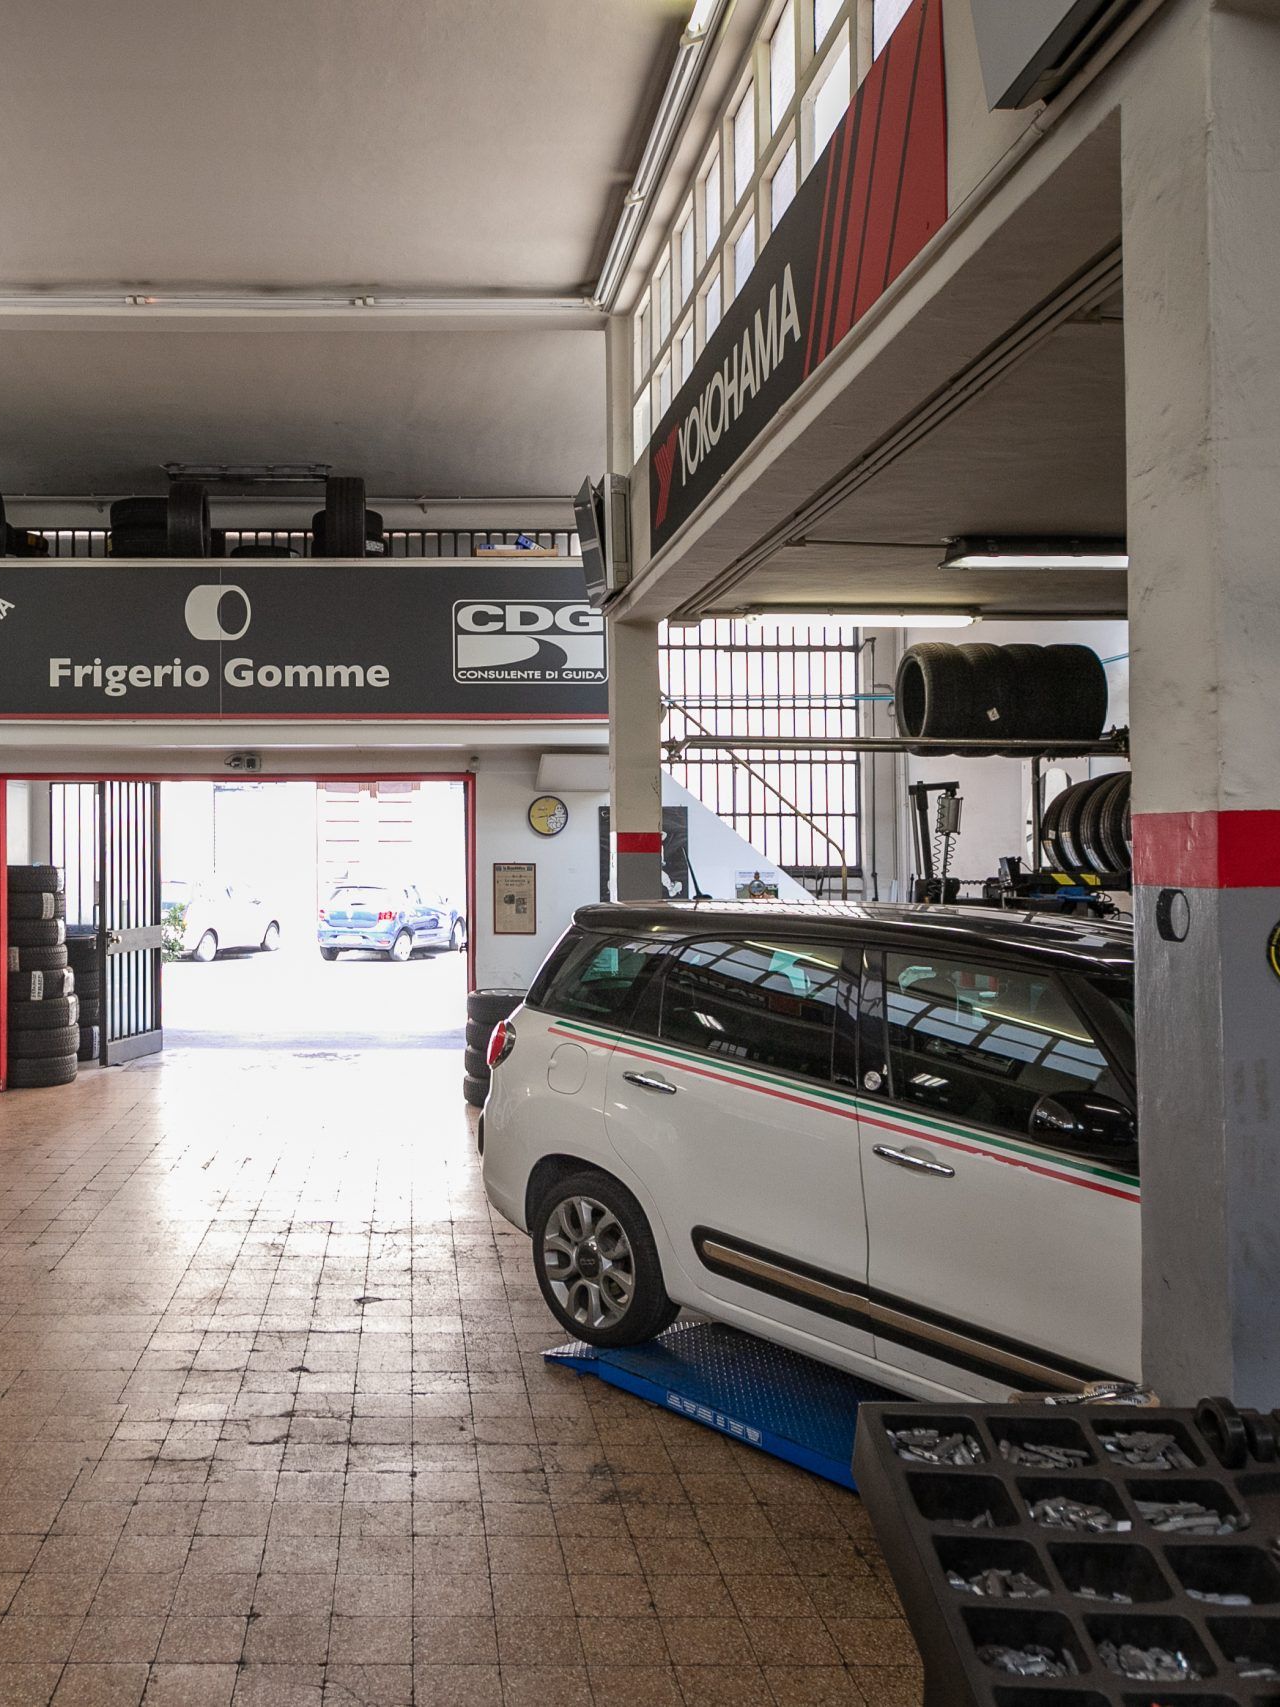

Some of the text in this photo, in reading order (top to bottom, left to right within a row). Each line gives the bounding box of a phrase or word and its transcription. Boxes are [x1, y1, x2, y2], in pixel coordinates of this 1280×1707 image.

[678, 262, 802, 487] YOKOHAMA
[456, 604, 604, 632] CDG
[48, 656, 390, 697] Frigerio Gomme
[457, 670, 605, 679] CONSULENTE DI GUIDA
